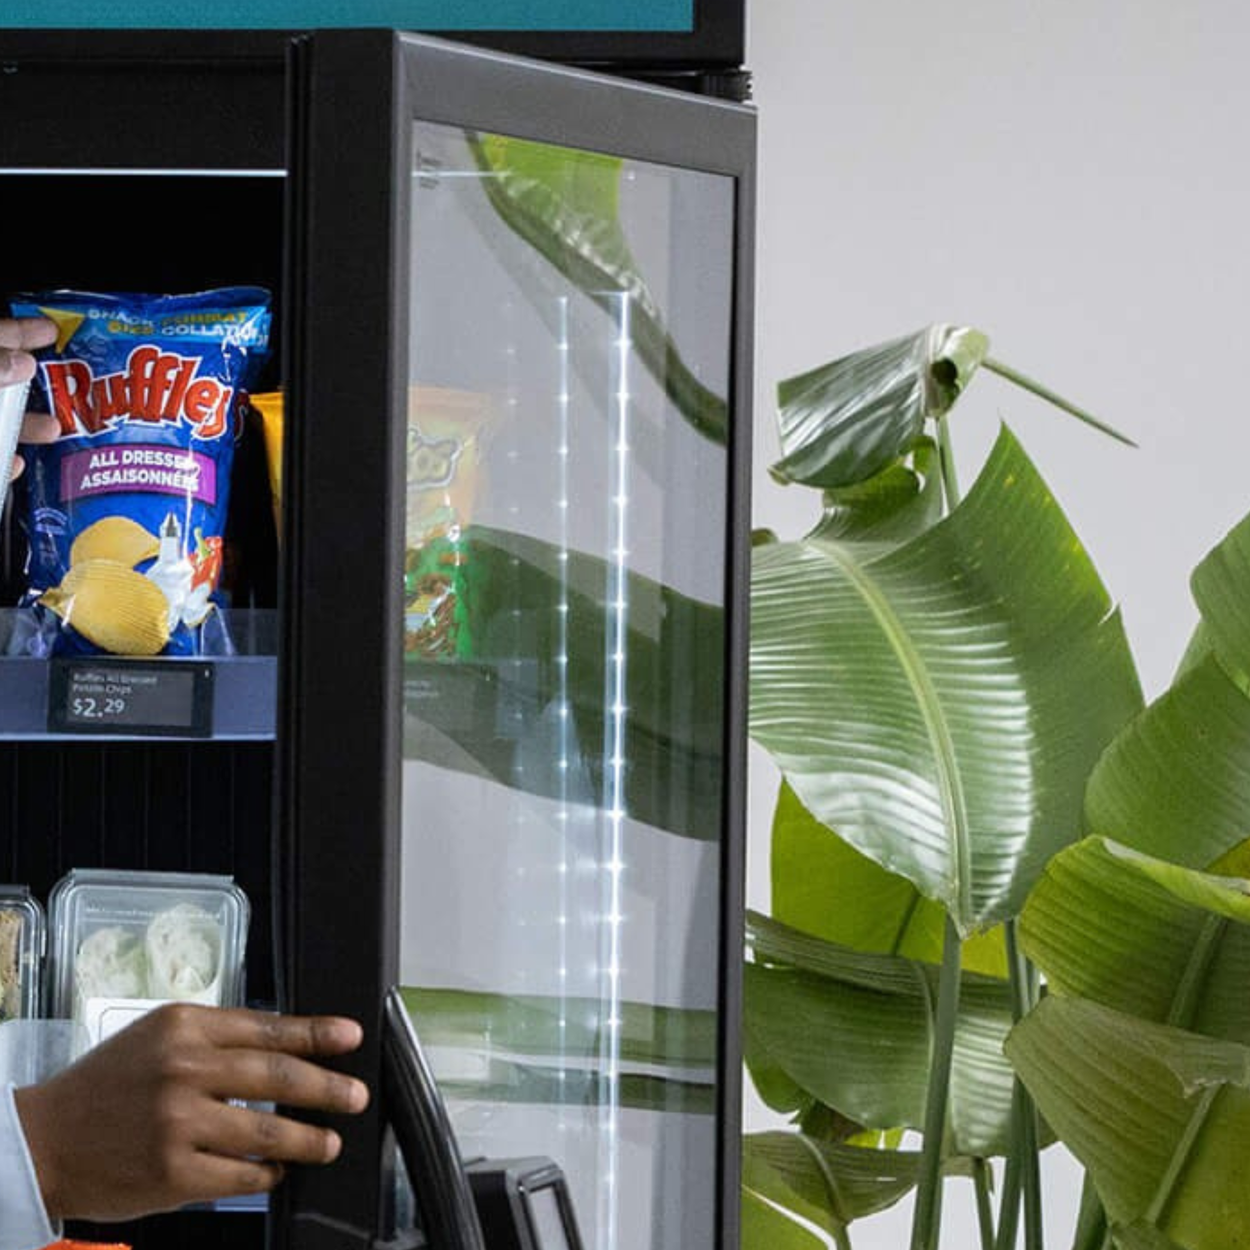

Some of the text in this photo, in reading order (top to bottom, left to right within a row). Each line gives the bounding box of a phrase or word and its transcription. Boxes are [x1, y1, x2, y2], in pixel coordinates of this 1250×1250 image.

[44, 345, 233, 440] Ruffles
[89, 451, 120, 469] ALL
[73, 698, 125, 718] $2.29
